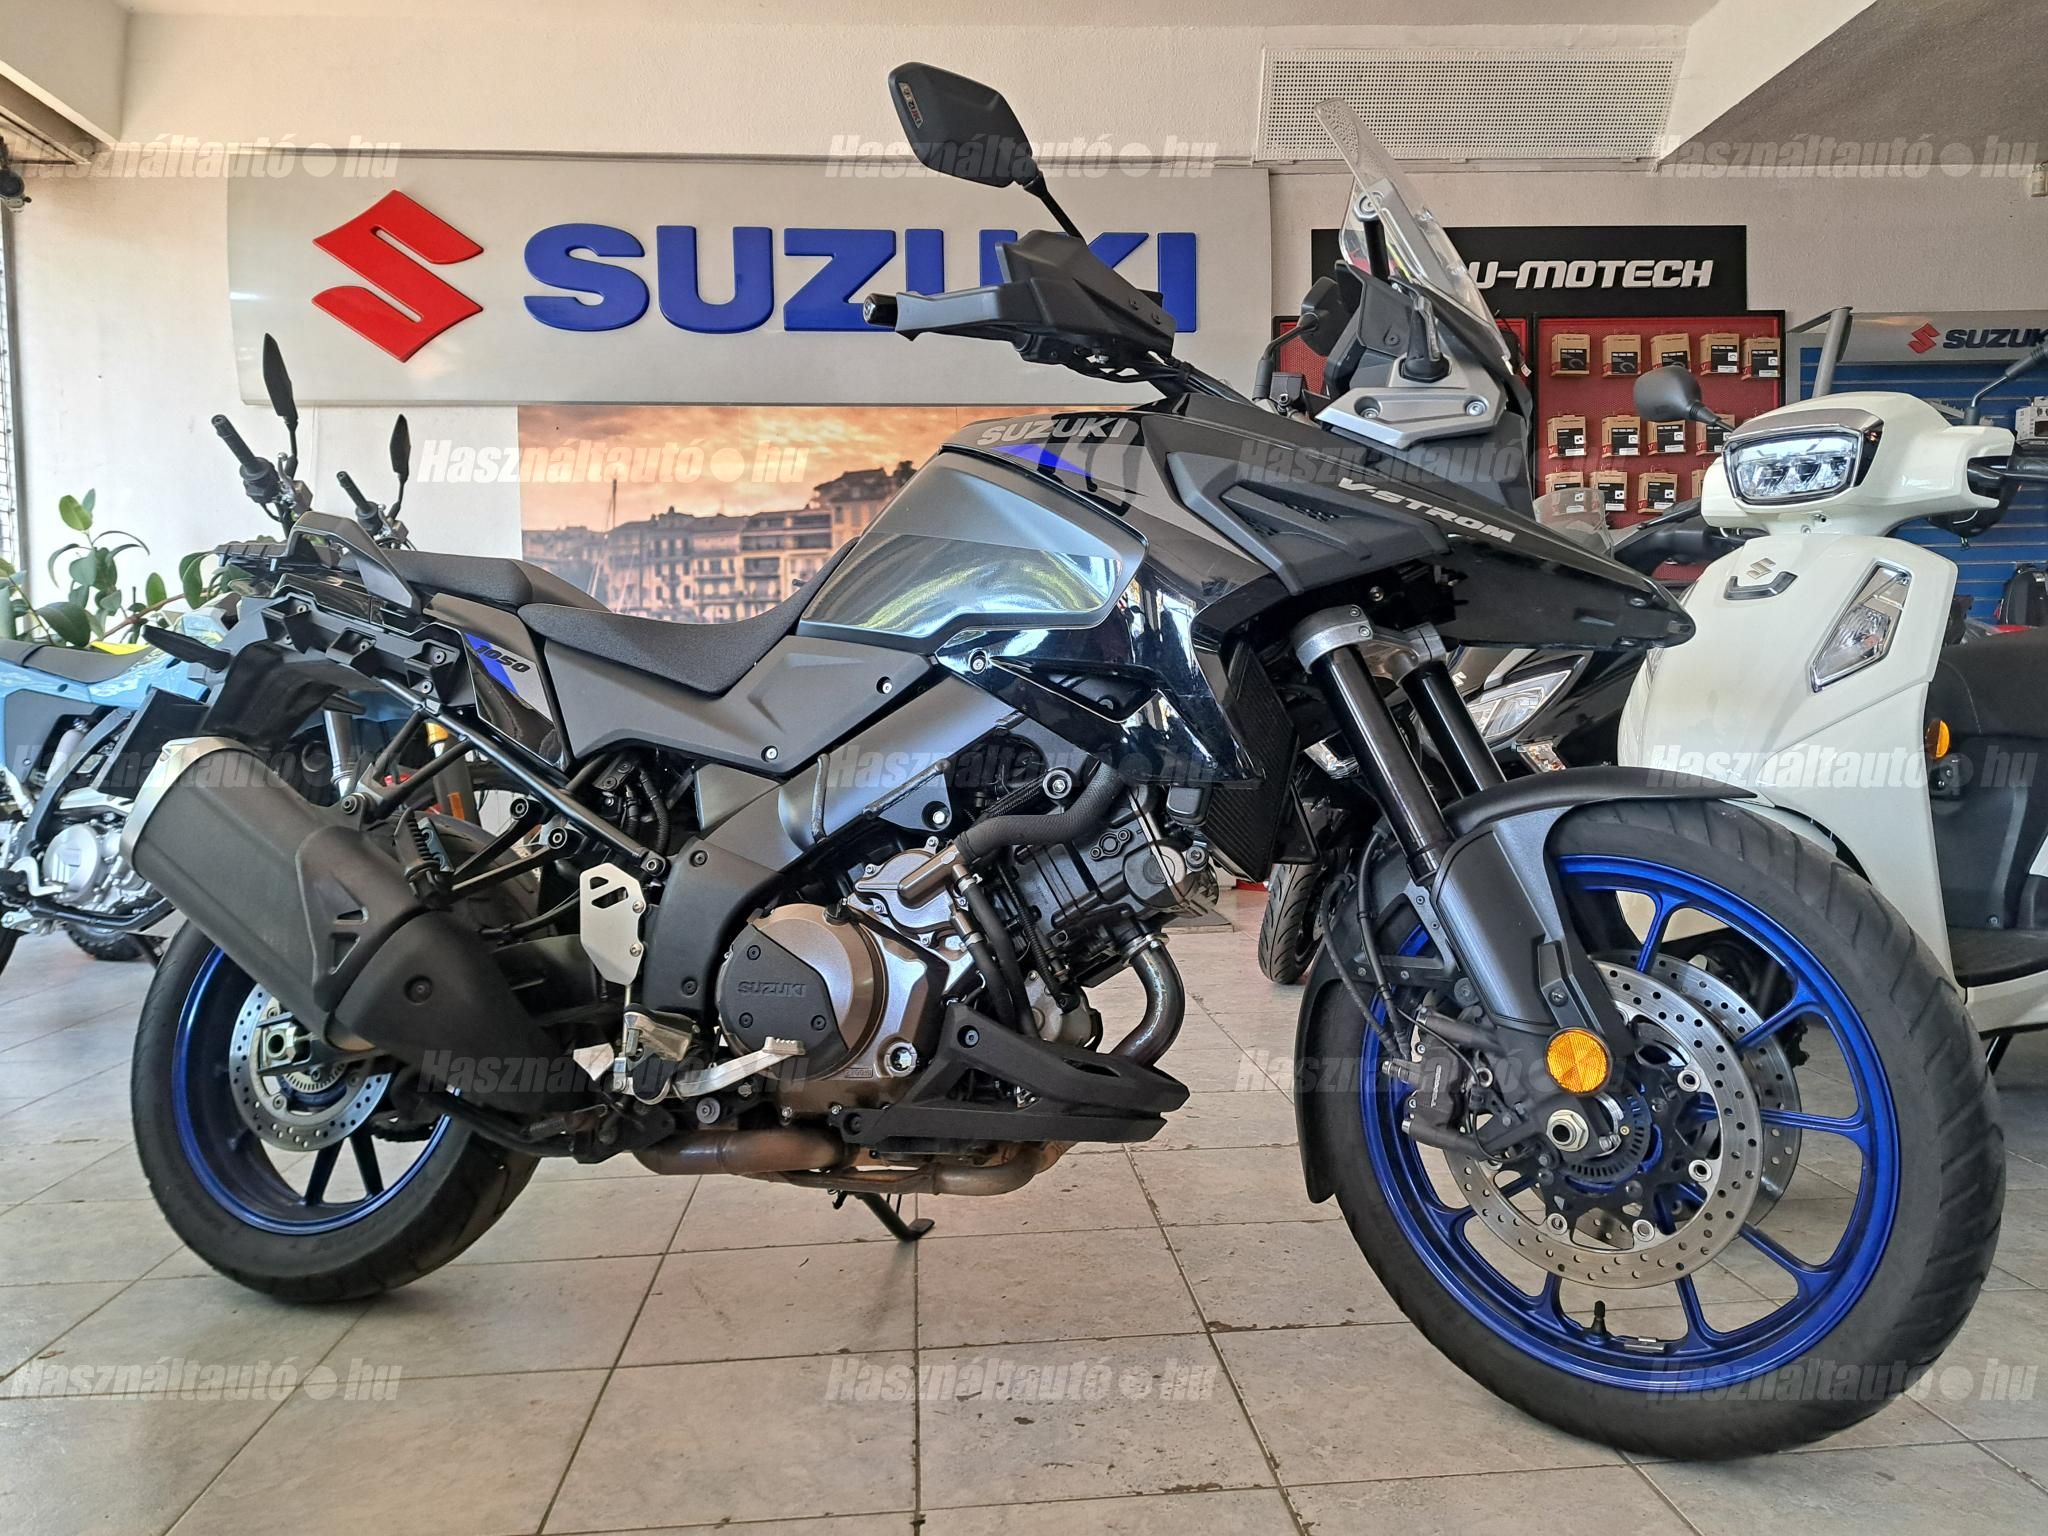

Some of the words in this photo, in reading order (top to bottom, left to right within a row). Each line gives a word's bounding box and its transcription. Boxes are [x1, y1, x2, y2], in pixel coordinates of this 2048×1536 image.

[977, 417, 1129, 446] SUZUKI
[1338, 477, 1516, 543] V-STROM
[475, 645, 531, 673] 1050
[738, 980, 807, 997] SUZUKI
